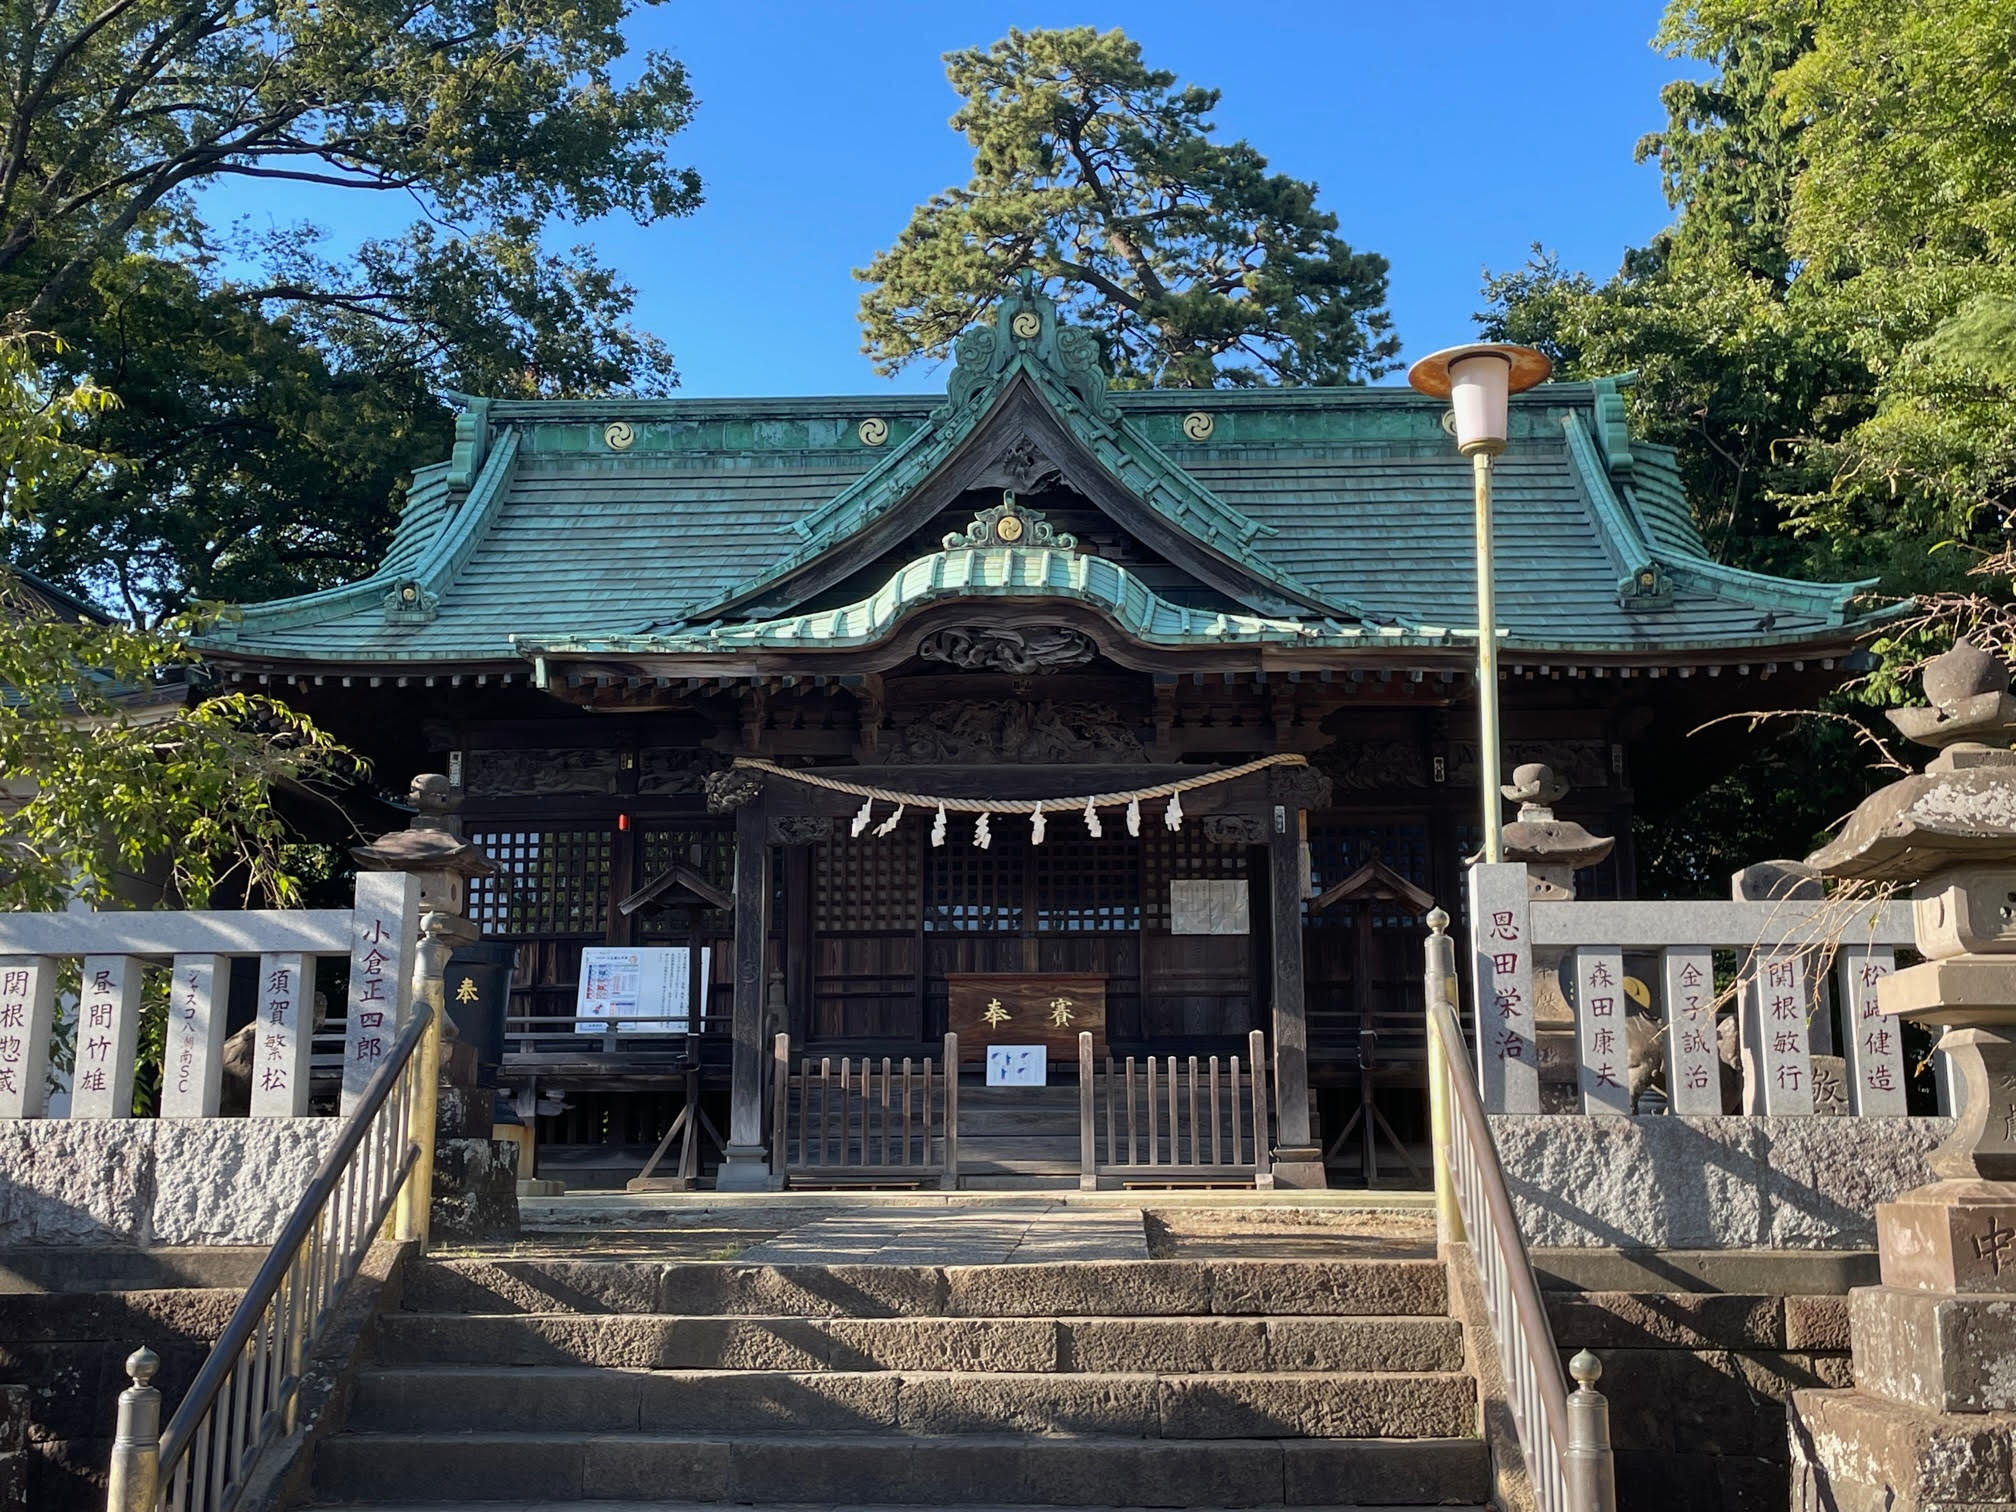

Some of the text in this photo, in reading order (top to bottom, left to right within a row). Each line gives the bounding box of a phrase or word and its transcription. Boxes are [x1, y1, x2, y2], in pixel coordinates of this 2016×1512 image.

[80, 970, 118, 1092] 昼間竹雄
[261, 969, 291, 1092] 須賀繁松
[356, 919, 390, 1063] 小倉正四郎
[456, 977, 479, 1004] 奉
[1489, 911, 1522, 1060] 恩田栄治
[1589, 960, 1622, 1089] 森田康夫
[1680, 962, 1710, 1089] 金子誠治
[1768, 961, 1803, 1091] 関根敏行
